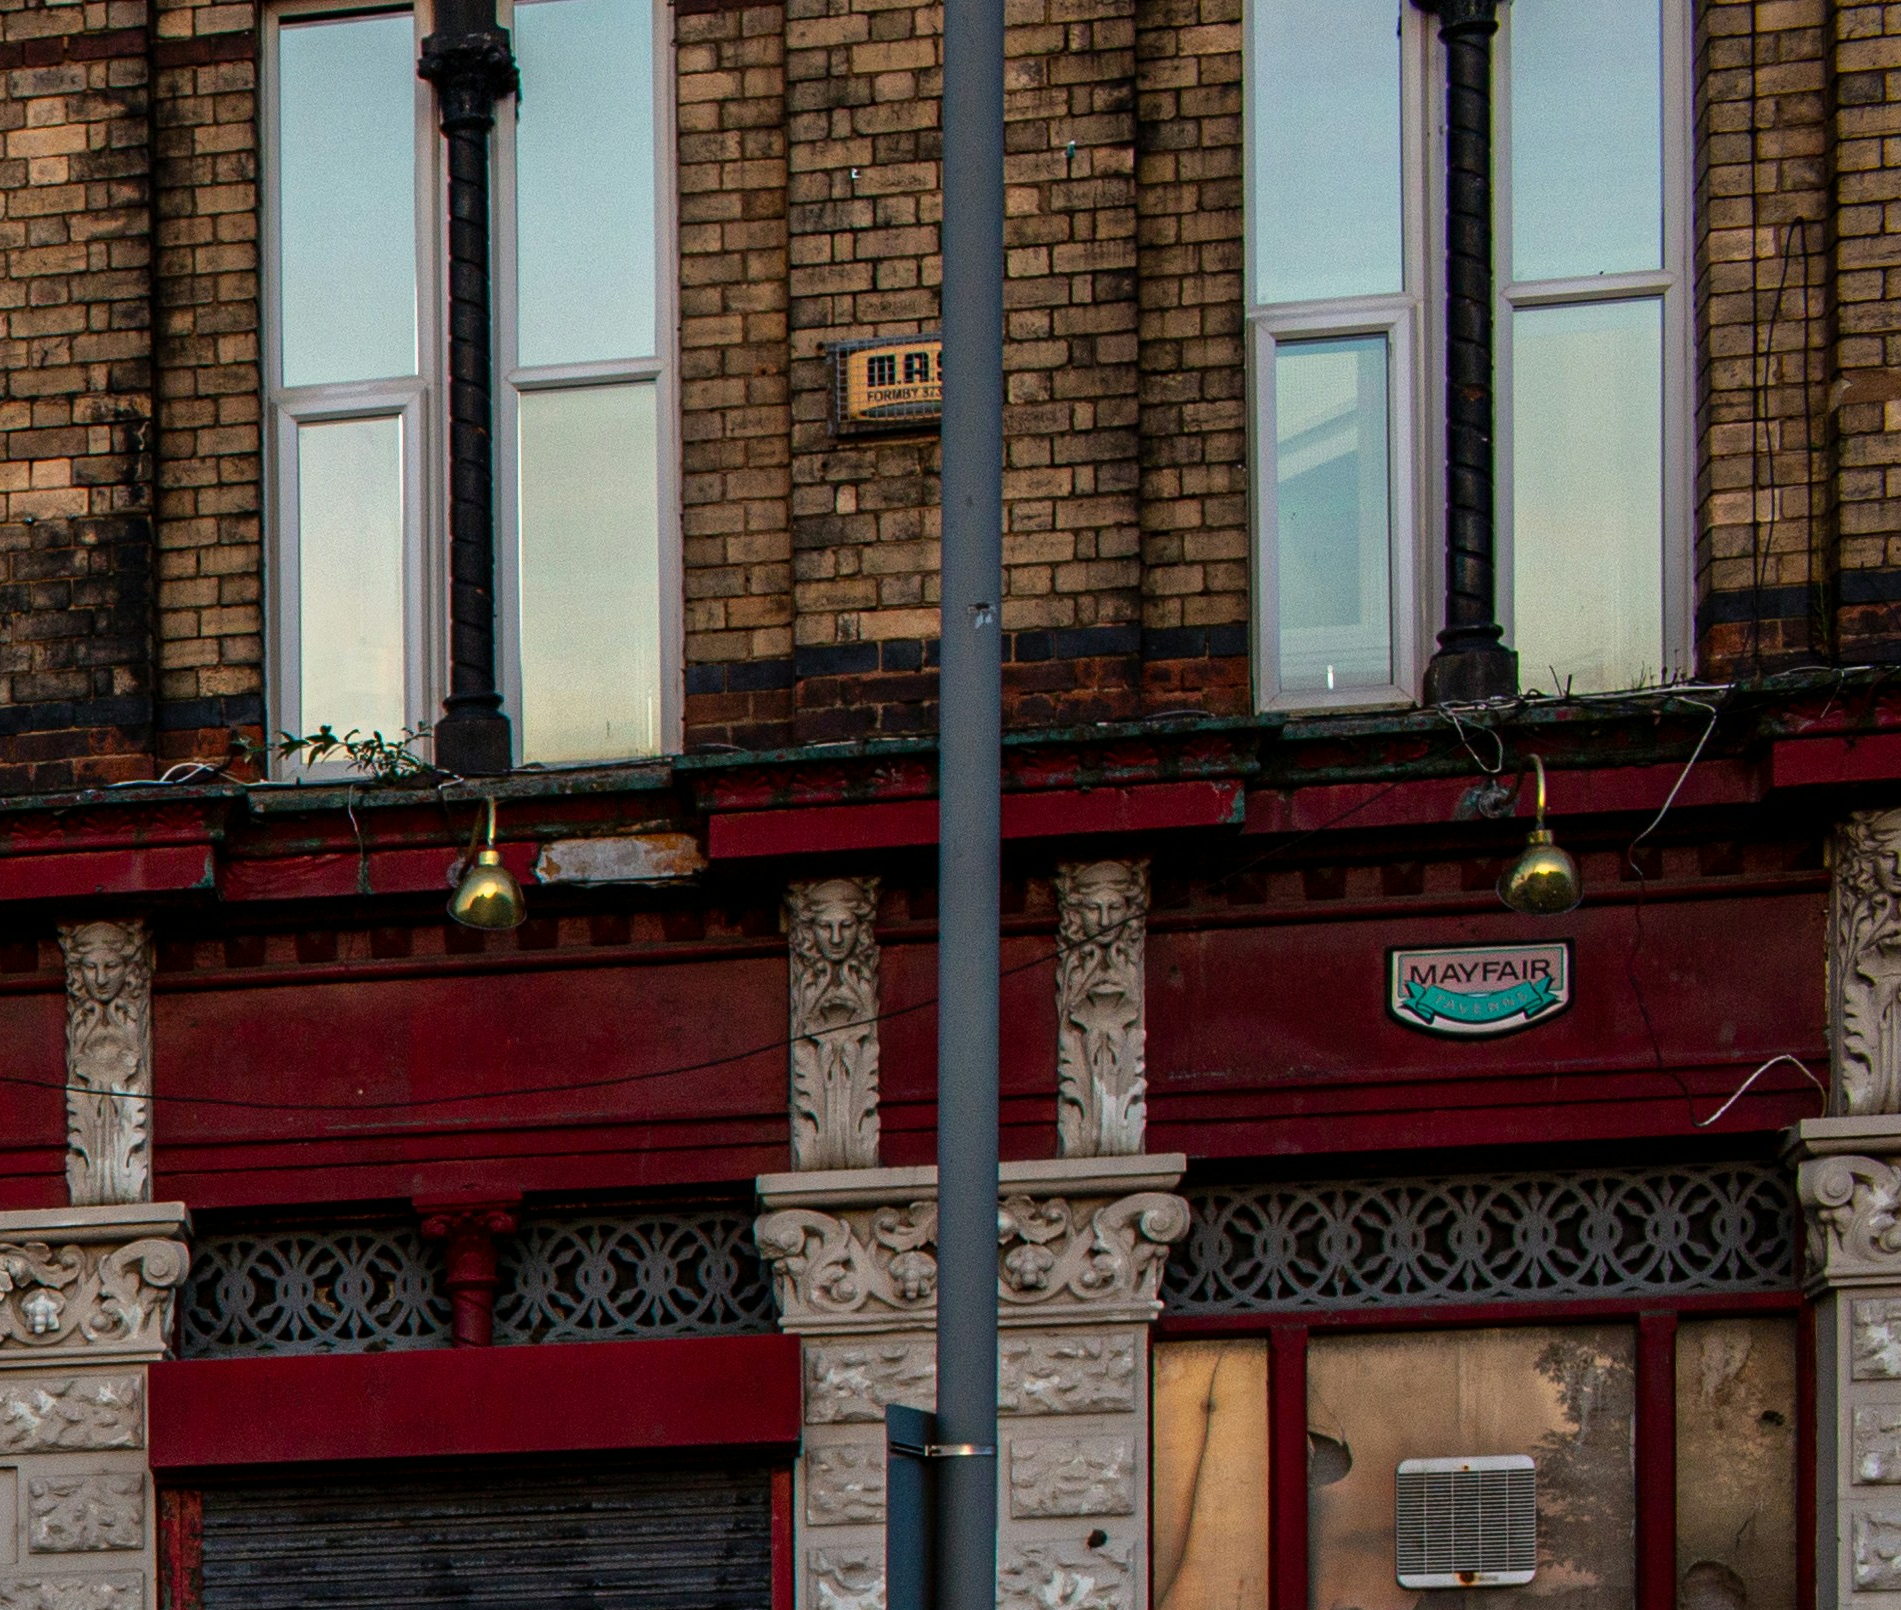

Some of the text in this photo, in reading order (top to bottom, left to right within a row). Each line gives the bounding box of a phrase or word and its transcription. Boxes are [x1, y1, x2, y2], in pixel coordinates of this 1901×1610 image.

[867, 387, 918, 402] FORMBY
[1410, 958, 1551, 985] MAYFAIR
[1435, 992, 1528, 1015] TAVERNS
